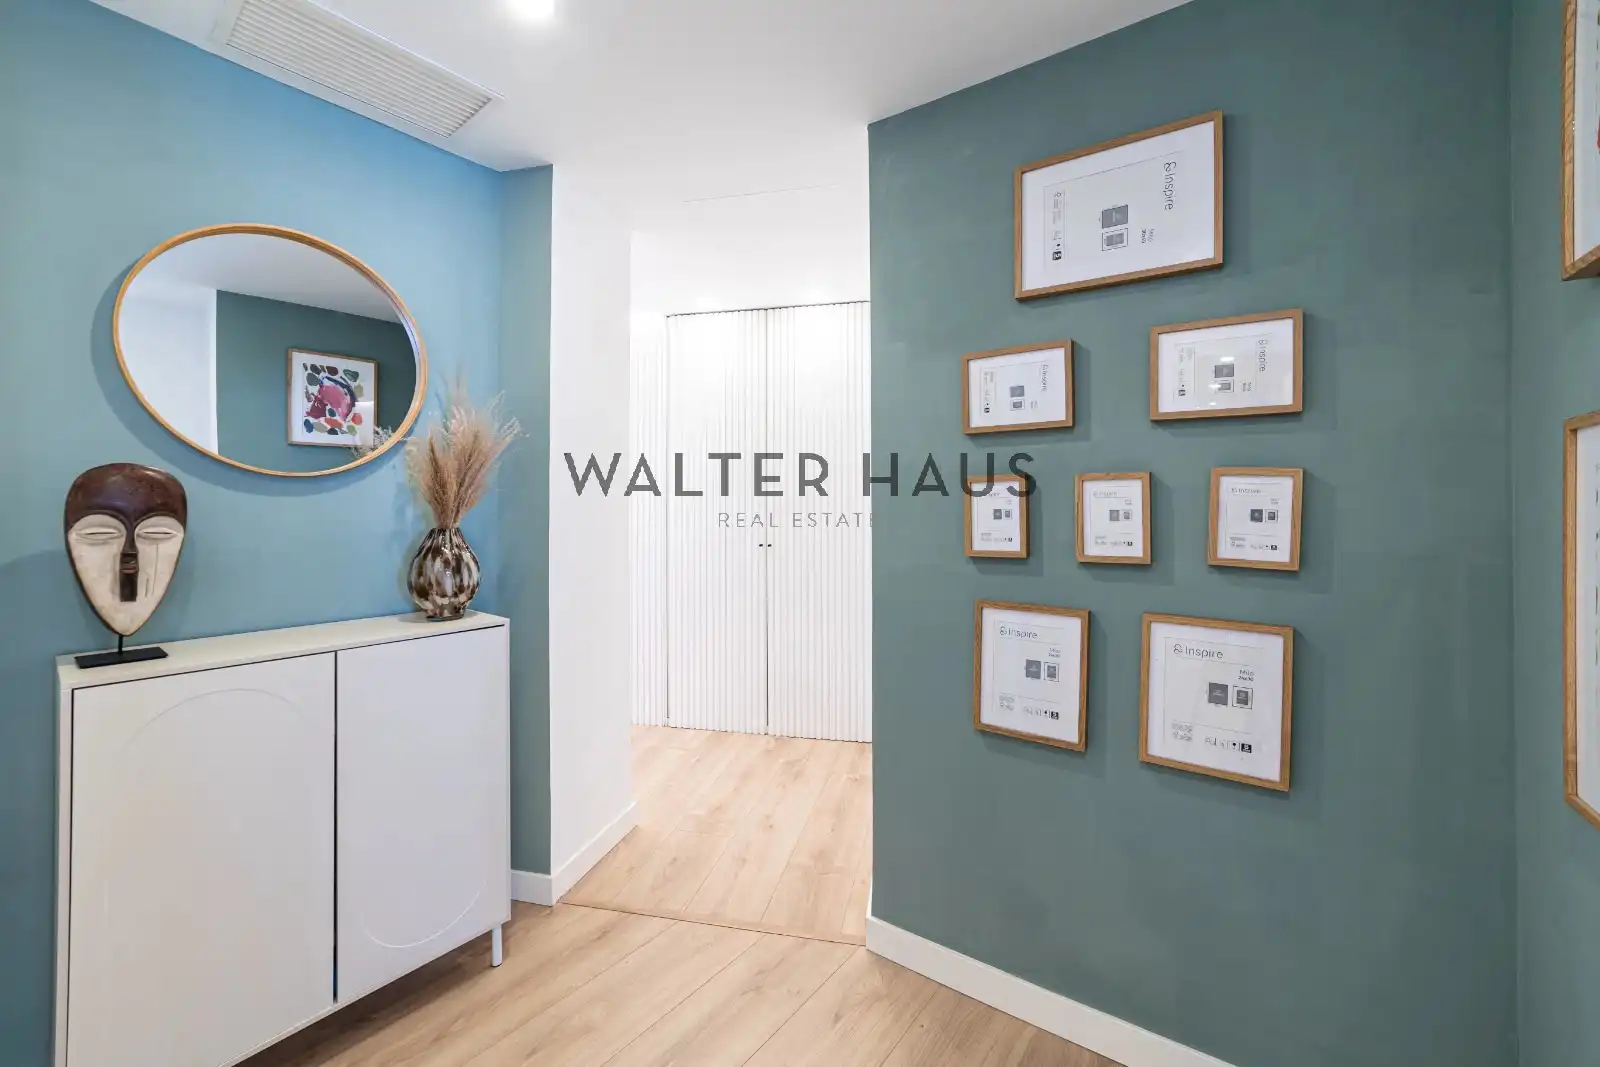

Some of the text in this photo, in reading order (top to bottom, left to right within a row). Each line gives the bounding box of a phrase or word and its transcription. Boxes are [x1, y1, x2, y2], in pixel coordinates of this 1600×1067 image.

[1162, 173, 1177, 211] Inspire
[1008, 627, 1038, 640] Inspire
[1185, 645, 1224, 660] Inspire
